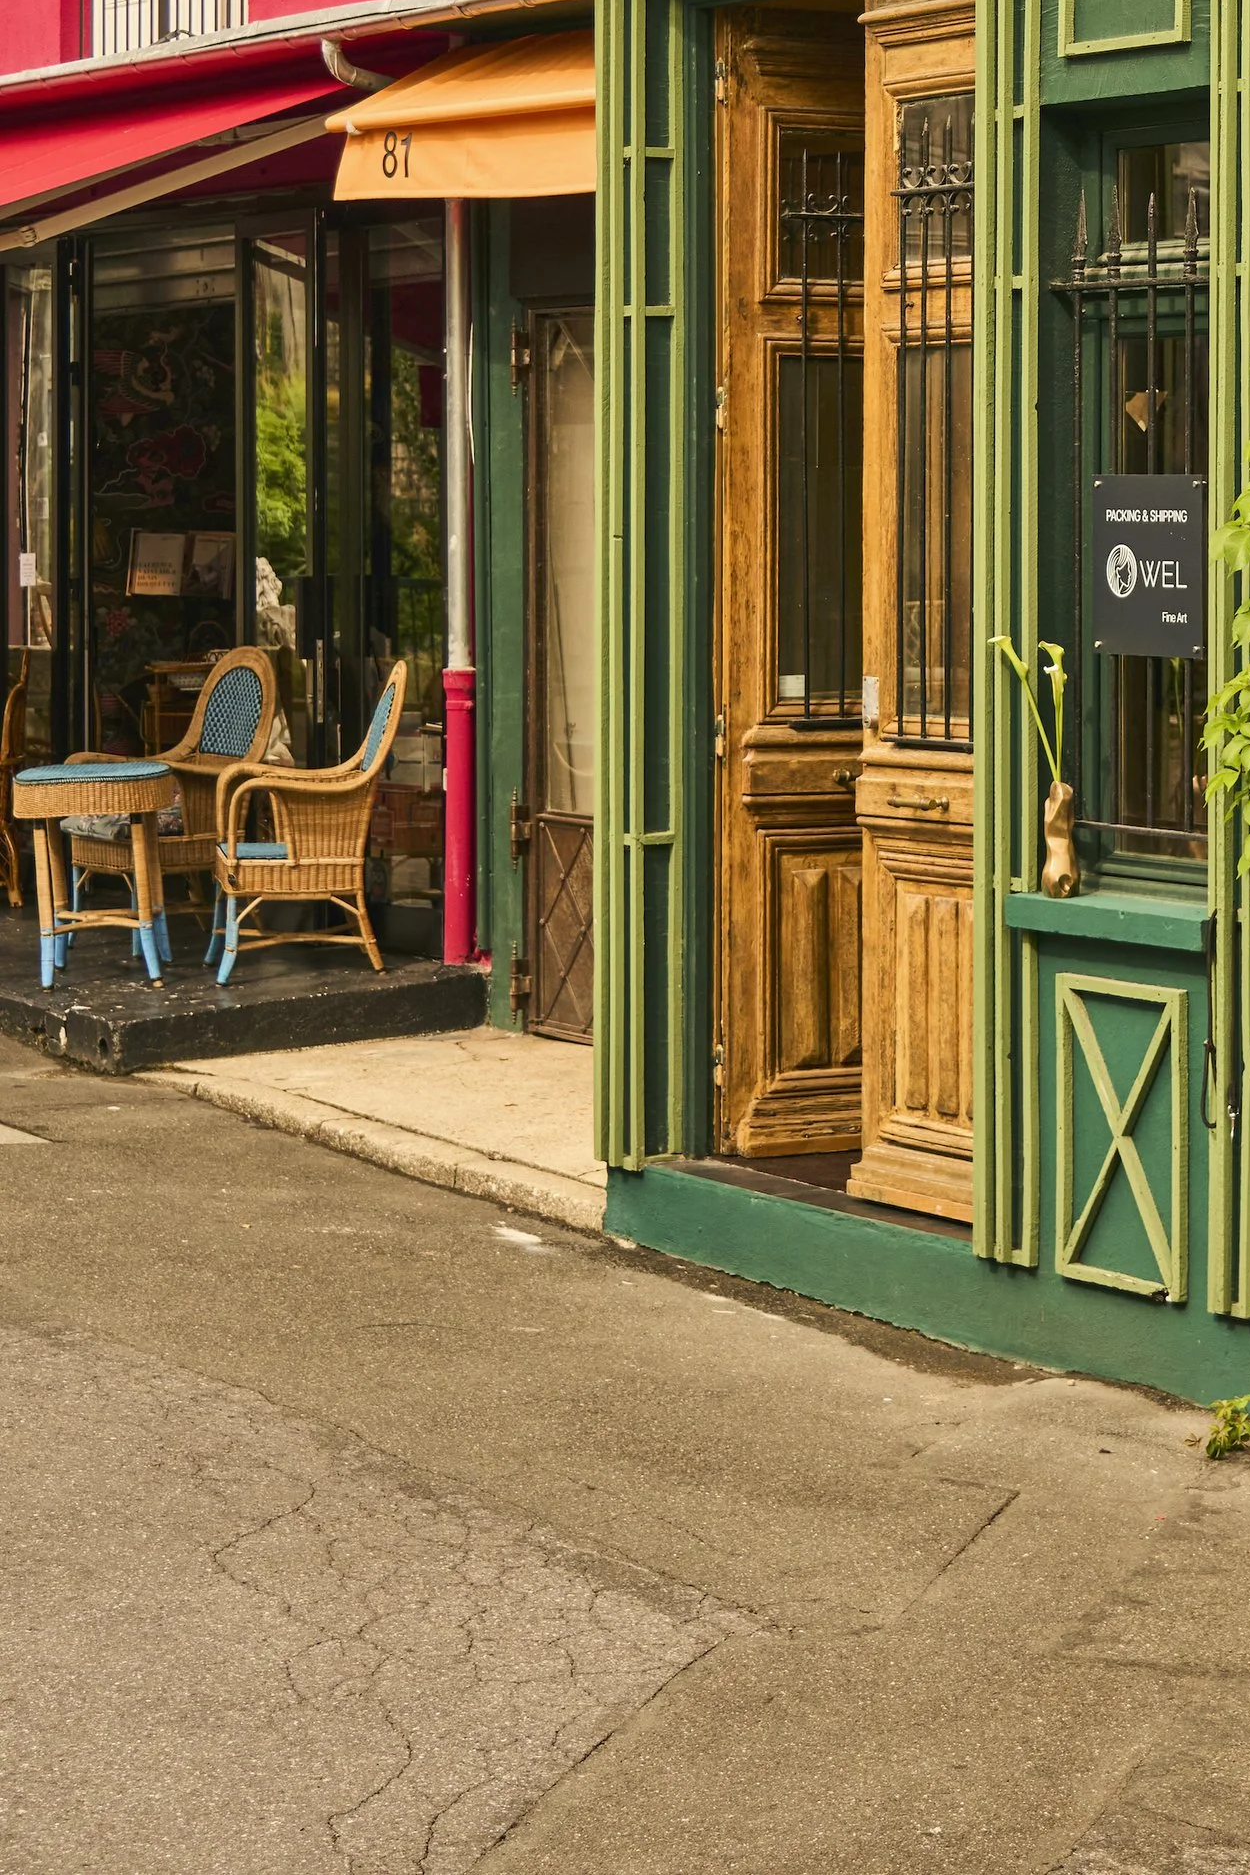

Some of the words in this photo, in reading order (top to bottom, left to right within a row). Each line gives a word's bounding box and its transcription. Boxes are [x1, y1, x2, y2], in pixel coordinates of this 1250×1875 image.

[382, 131, 413, 178] 81
[1106, 509, 1141, 522] PACKING
[1142, 509, 1149, 522] &
[1150, 509, 1188, 523] SHIPPING
[1139, 560, 1188, 588] WEL
[1161, 611, 1176, 623] Fine
[1176, 612, 1188, 624] Art
